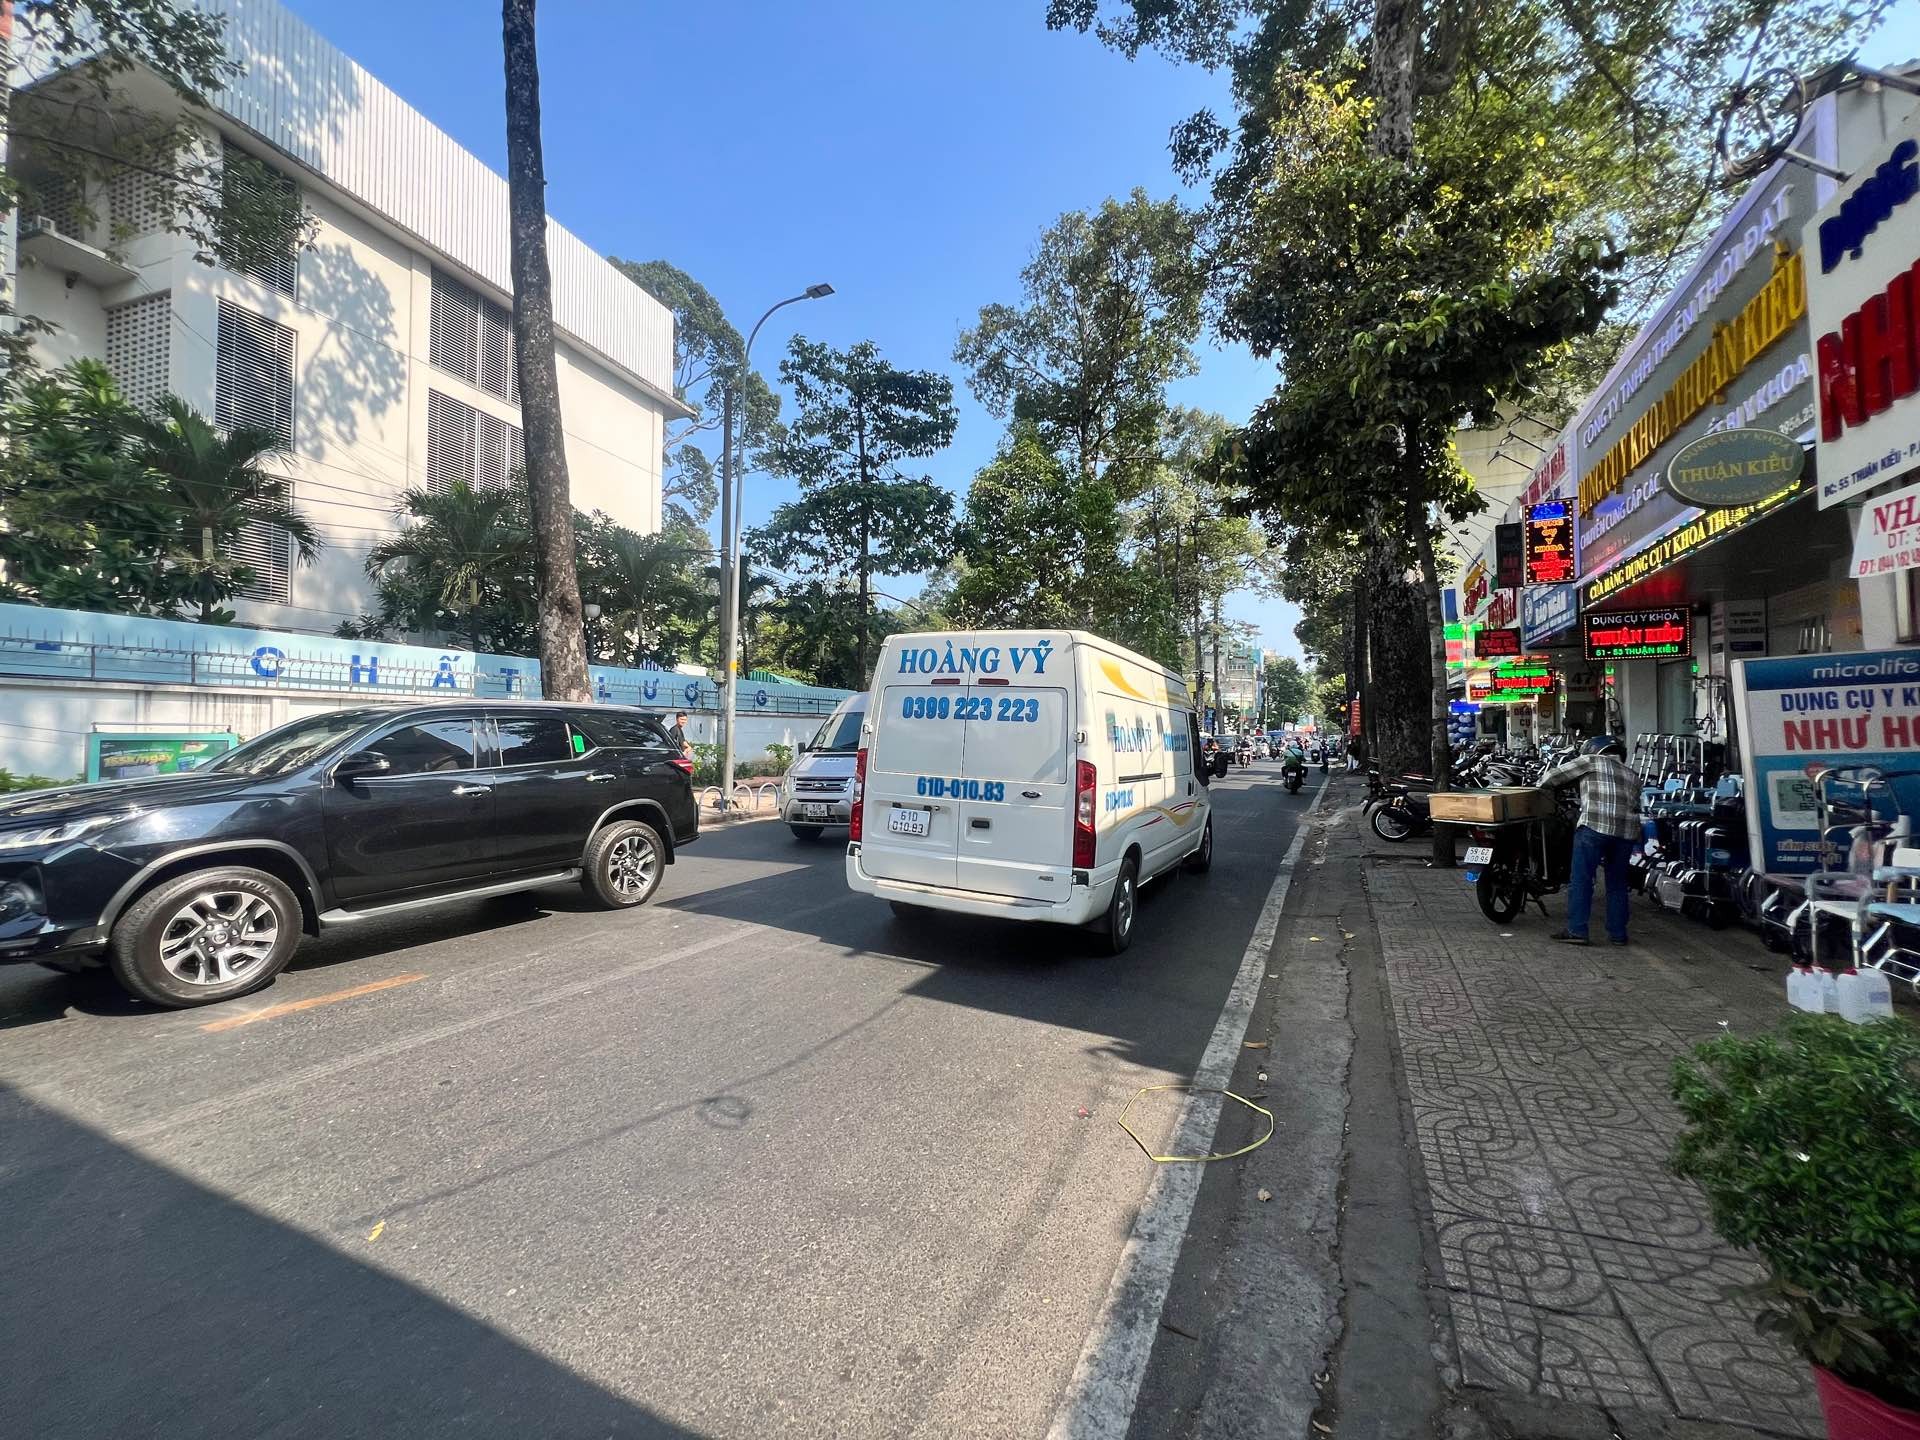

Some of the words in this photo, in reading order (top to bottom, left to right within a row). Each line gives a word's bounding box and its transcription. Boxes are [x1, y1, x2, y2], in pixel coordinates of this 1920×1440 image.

[1817, 258, 1920, 443] NH
[1578, 463, 1603, 518] DỤNG
[1618, 432, 1630, 477] Y
[1630, 390, 1671, 469] KHOA
[1673, 315, 1744, 428] THUẬN
[1743, 238, 1808, 367] KIỀU
[1620, 351, 1654, 404] TNHH
[1605, 502, 1626, 530] CUNG
[1643, 472, 1660, 501] CÁC
[1756, 353, 1810, 414] KHOA
[1679, 460, 1743, 484] THUẬN
[1747, 450, 1794, 476] KIỀU
[1851, 462, 1878, 484] THUẬN
[1873, 495, 1920, 535] NH
[1625, 555, 1649, 583] DỤNG
[1649, 548, 1663, 569] CỤ
[1663, 541, 1673, 558] Y
[1673, 521, 1706, 555] KHOA
[1590, 627, 1643, 647] THUẬN
[1644, 621, 1685, 643] KIỀU
[1592, 615, 1622, 626] DỤNG
[1624, 614, 1638, 624] CỤ
[1640, 614, 1648, 622] Y
[1649, 612, 1680, 622] KHOA
[898, 639, 1001, 674] HOÀNG
[1009, 639, 1054, 674] VỸ
[1625, 646, 1655, 655] THUẬN
[1656, 643, 1679, 653] KIỀU
[1812, 657, 1920, 679] microlife
[902, 696, 950, 719] 0399
[953, 697, 993, 721] 223
[997, 697, 1040, 723] 223
[1781, 691, 1839, 716] DỤNG
[1846, 688, 1874, 712] CỤ
[1881, 687, 1894, 708] Y
[1902, 686, 1920, 707] K
[1783, 713, 1871, 751] NHƯ
[917, 776, 1005, 802] 61D-010.83
[892, 820, 924, 834] 010.83
[900, 811, 918, 821] 61D
